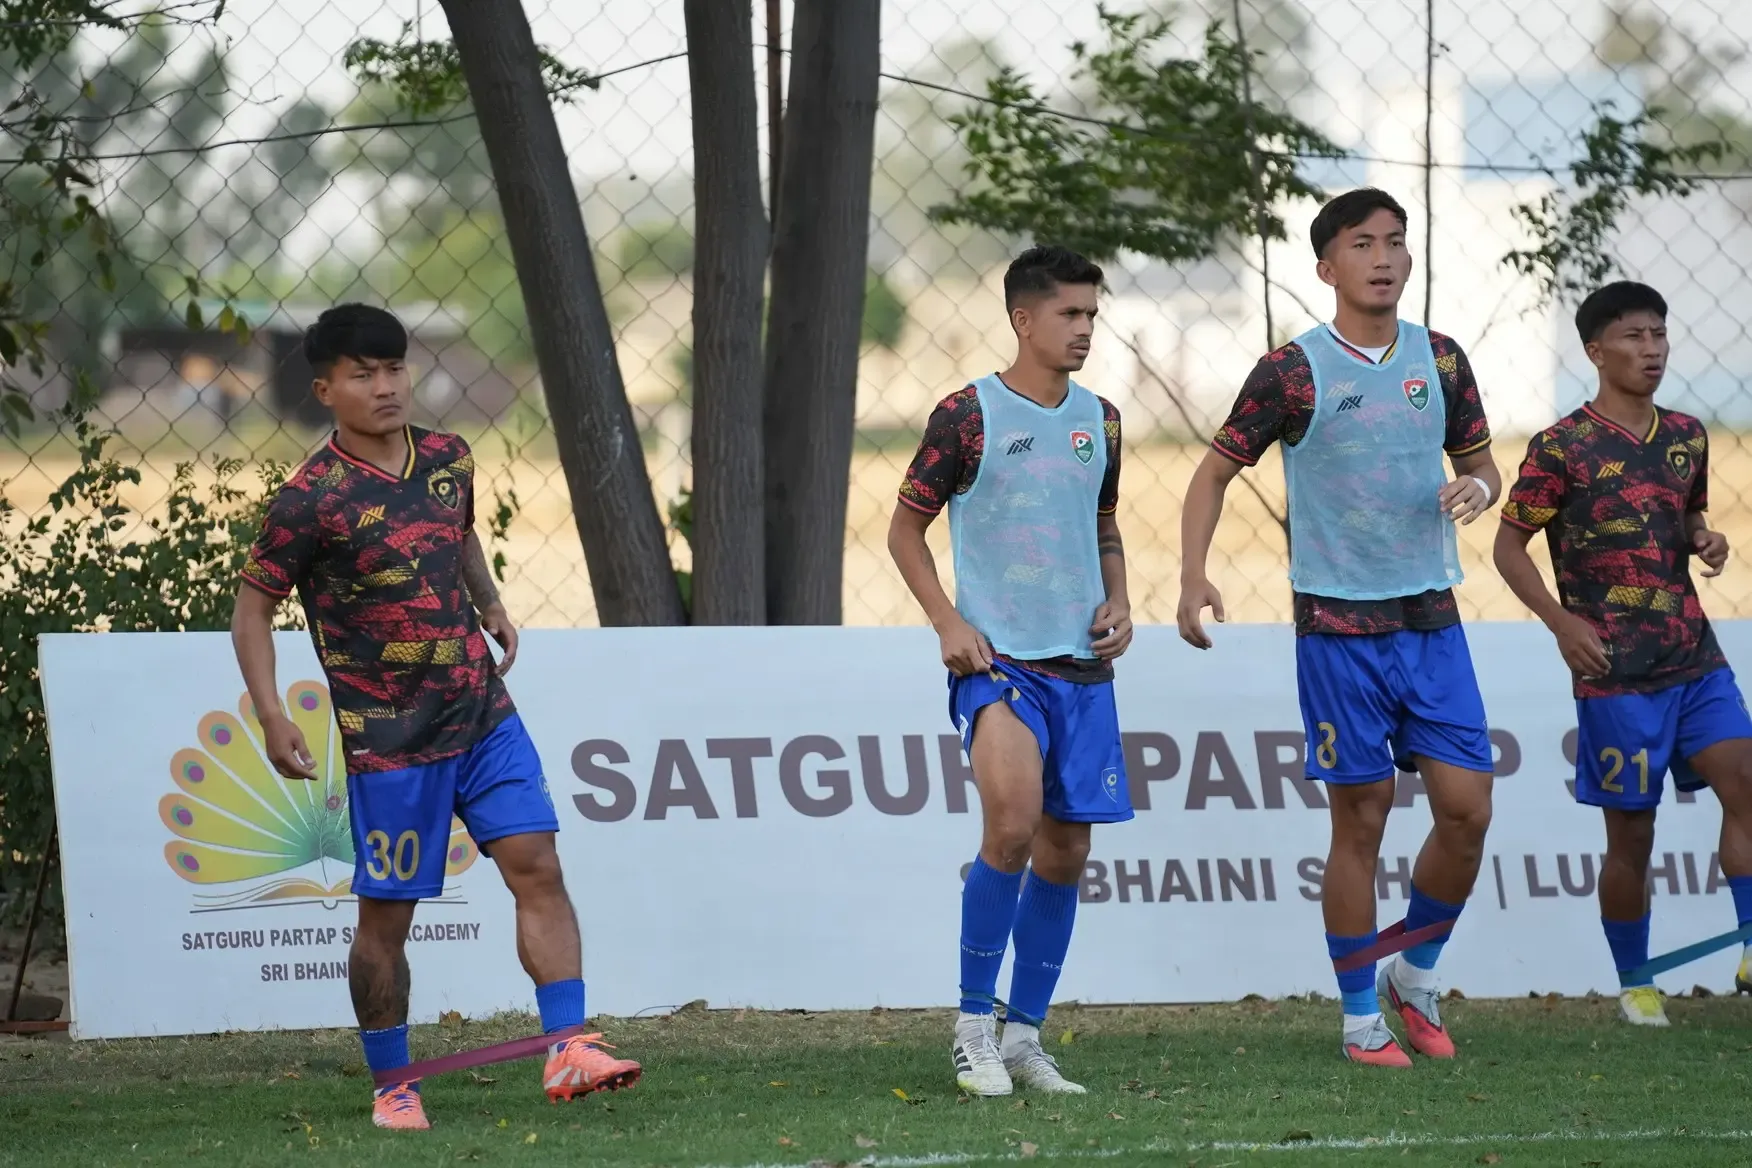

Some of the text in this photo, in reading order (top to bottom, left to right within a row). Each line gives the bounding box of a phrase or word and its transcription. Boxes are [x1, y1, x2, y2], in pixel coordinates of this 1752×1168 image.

[1316, 721, 1337, 769] 8
[571, 735, 978, 822] SATGUR
[1600, 747, 1648, 794] 21
[366, 829, 420, 881] 30
[1078, 857, 1277, 903] BHAINI
[182, 930, 264, 950] SATGURU
[270, 928, 337, 947] PARTAP
[406, 923, 481, 942] CADEMY
[261, 961, 349, 982] SRI BHAIN
